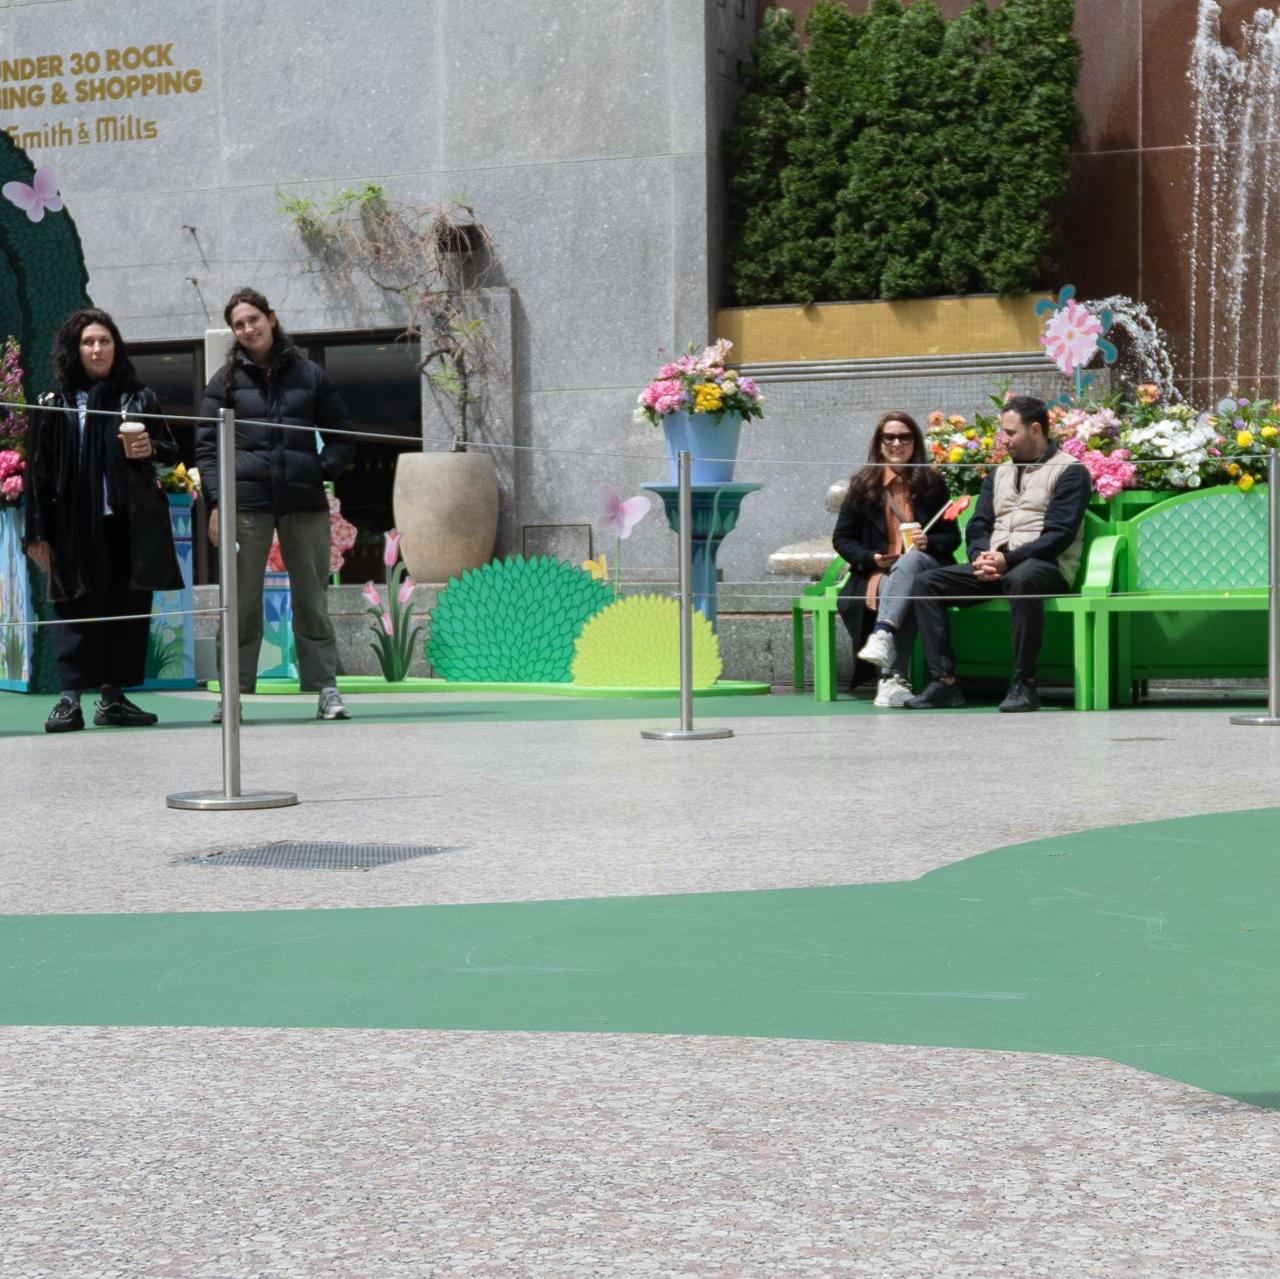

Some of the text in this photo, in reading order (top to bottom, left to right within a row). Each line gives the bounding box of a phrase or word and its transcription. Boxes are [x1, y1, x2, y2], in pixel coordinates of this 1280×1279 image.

[0, 43, 174, 82] NDER 30 ROCK
[0, 68, 203, 110] ING & SHOPPING
[78, 122, 91, 144] &
[96, 114, 158, 144] Mills
